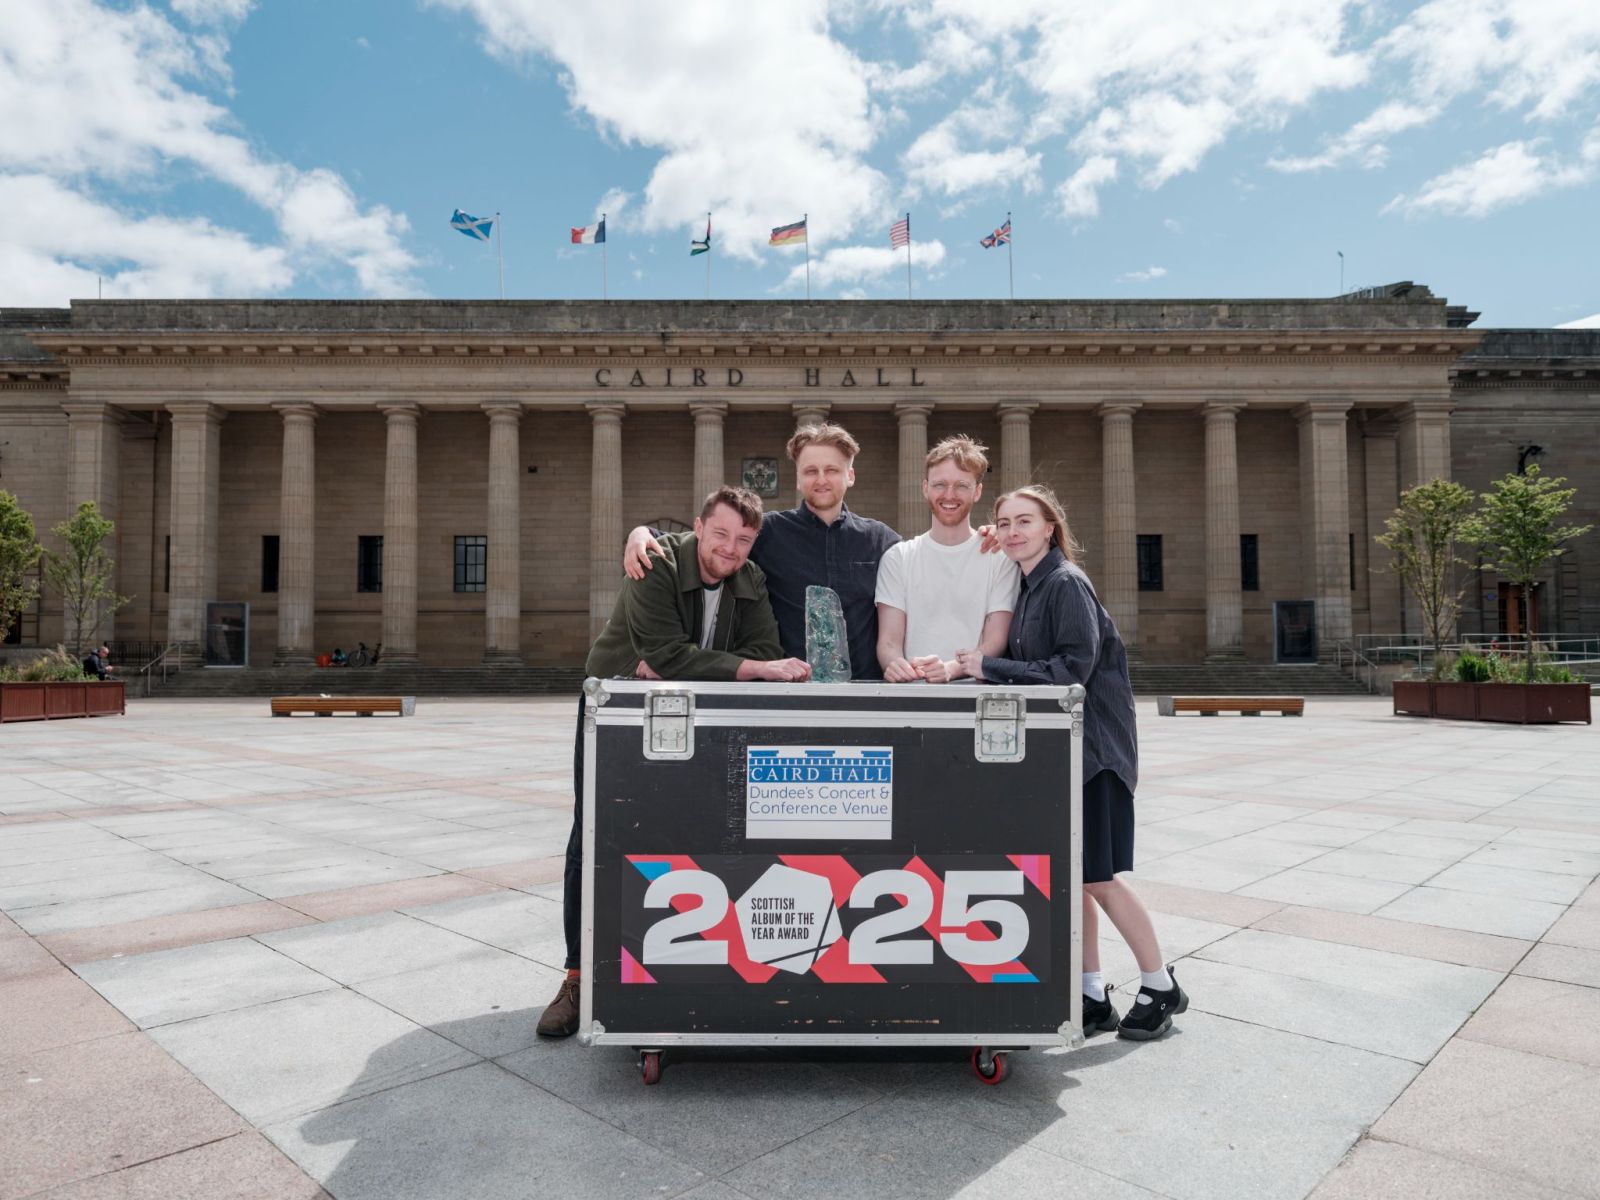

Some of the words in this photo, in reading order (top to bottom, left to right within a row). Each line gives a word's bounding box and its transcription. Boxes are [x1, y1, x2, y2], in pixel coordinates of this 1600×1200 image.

[594, 368, 744, 387] CAIRD
[804, 368, 924, 387] HALL
[751, 767, 819, 781] CAIRD
[831, 767, 888, 781] HALL
[750, 786, 814, 799] Dundee's
[818, 786, 875, 799] Concert
[880, 787, 890, 799] &
[750, 802, 837, 815] Conference
[842, 802, 888, 815] Venue
[751, 898, 795, 910] SCOTTISH
[751, 912, 782, 925] ALBUM
[785, 912, 796, 925] OF
[798, 912, 814, 925] THE
[751, 927, 775, 940] YEAR
[777, 927, 809, 940] AWARD
